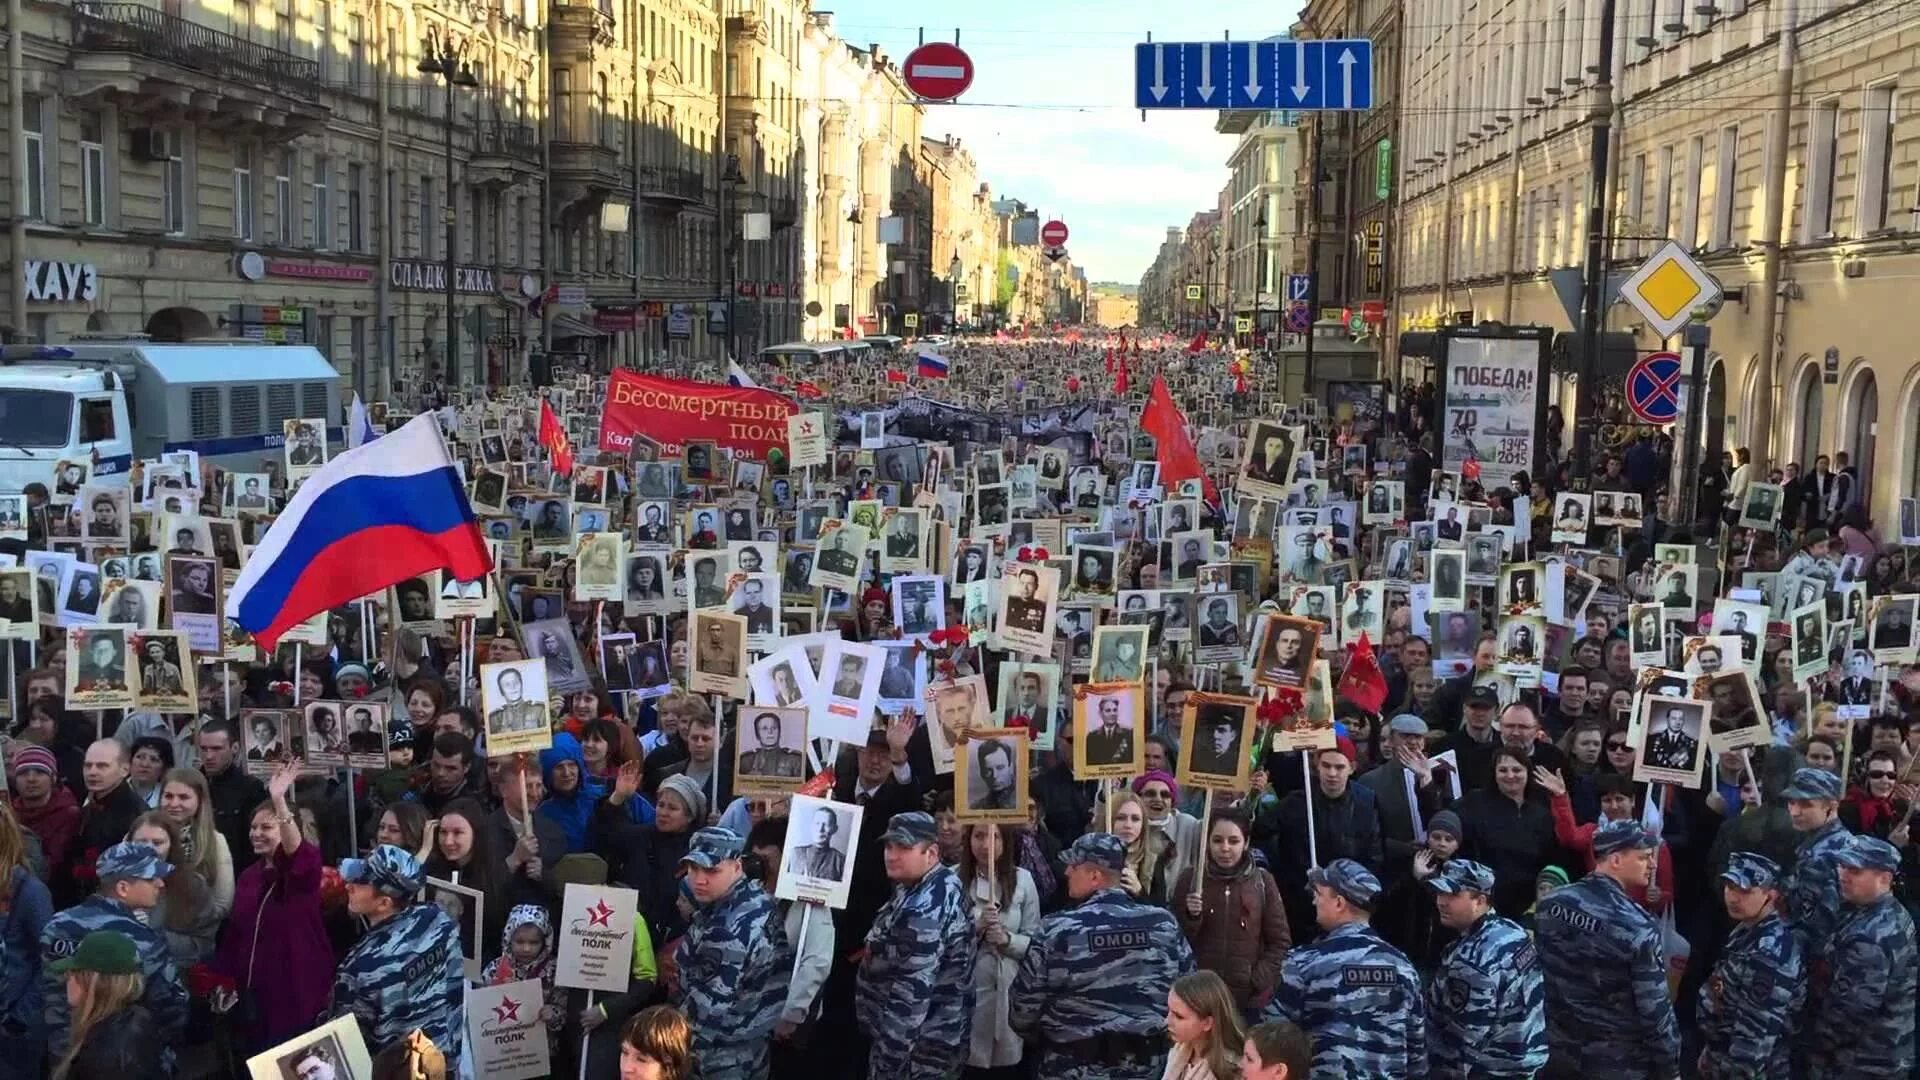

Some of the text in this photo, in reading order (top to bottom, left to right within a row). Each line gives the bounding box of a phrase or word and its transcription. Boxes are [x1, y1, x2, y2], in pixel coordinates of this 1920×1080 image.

[25, 261, 97, 300] ХАУЗ
[392, 262, 494, 292] СЛАДКЕЖКА
[1454, 366, 1533, 390] ПОБЕДА!
[613, 381, 790, 421] Бессмертный
[1501, 438, 1528, 452] 1945
[1497, 451, 1528, 465] 2015
[1551, 904, 1598, 931] ОМОН
[1094, 931, 1146, 948] ОМОН
[407, 945, 444, 980] ОМОН
[1347, 969, 1394, 983] ОМОН
